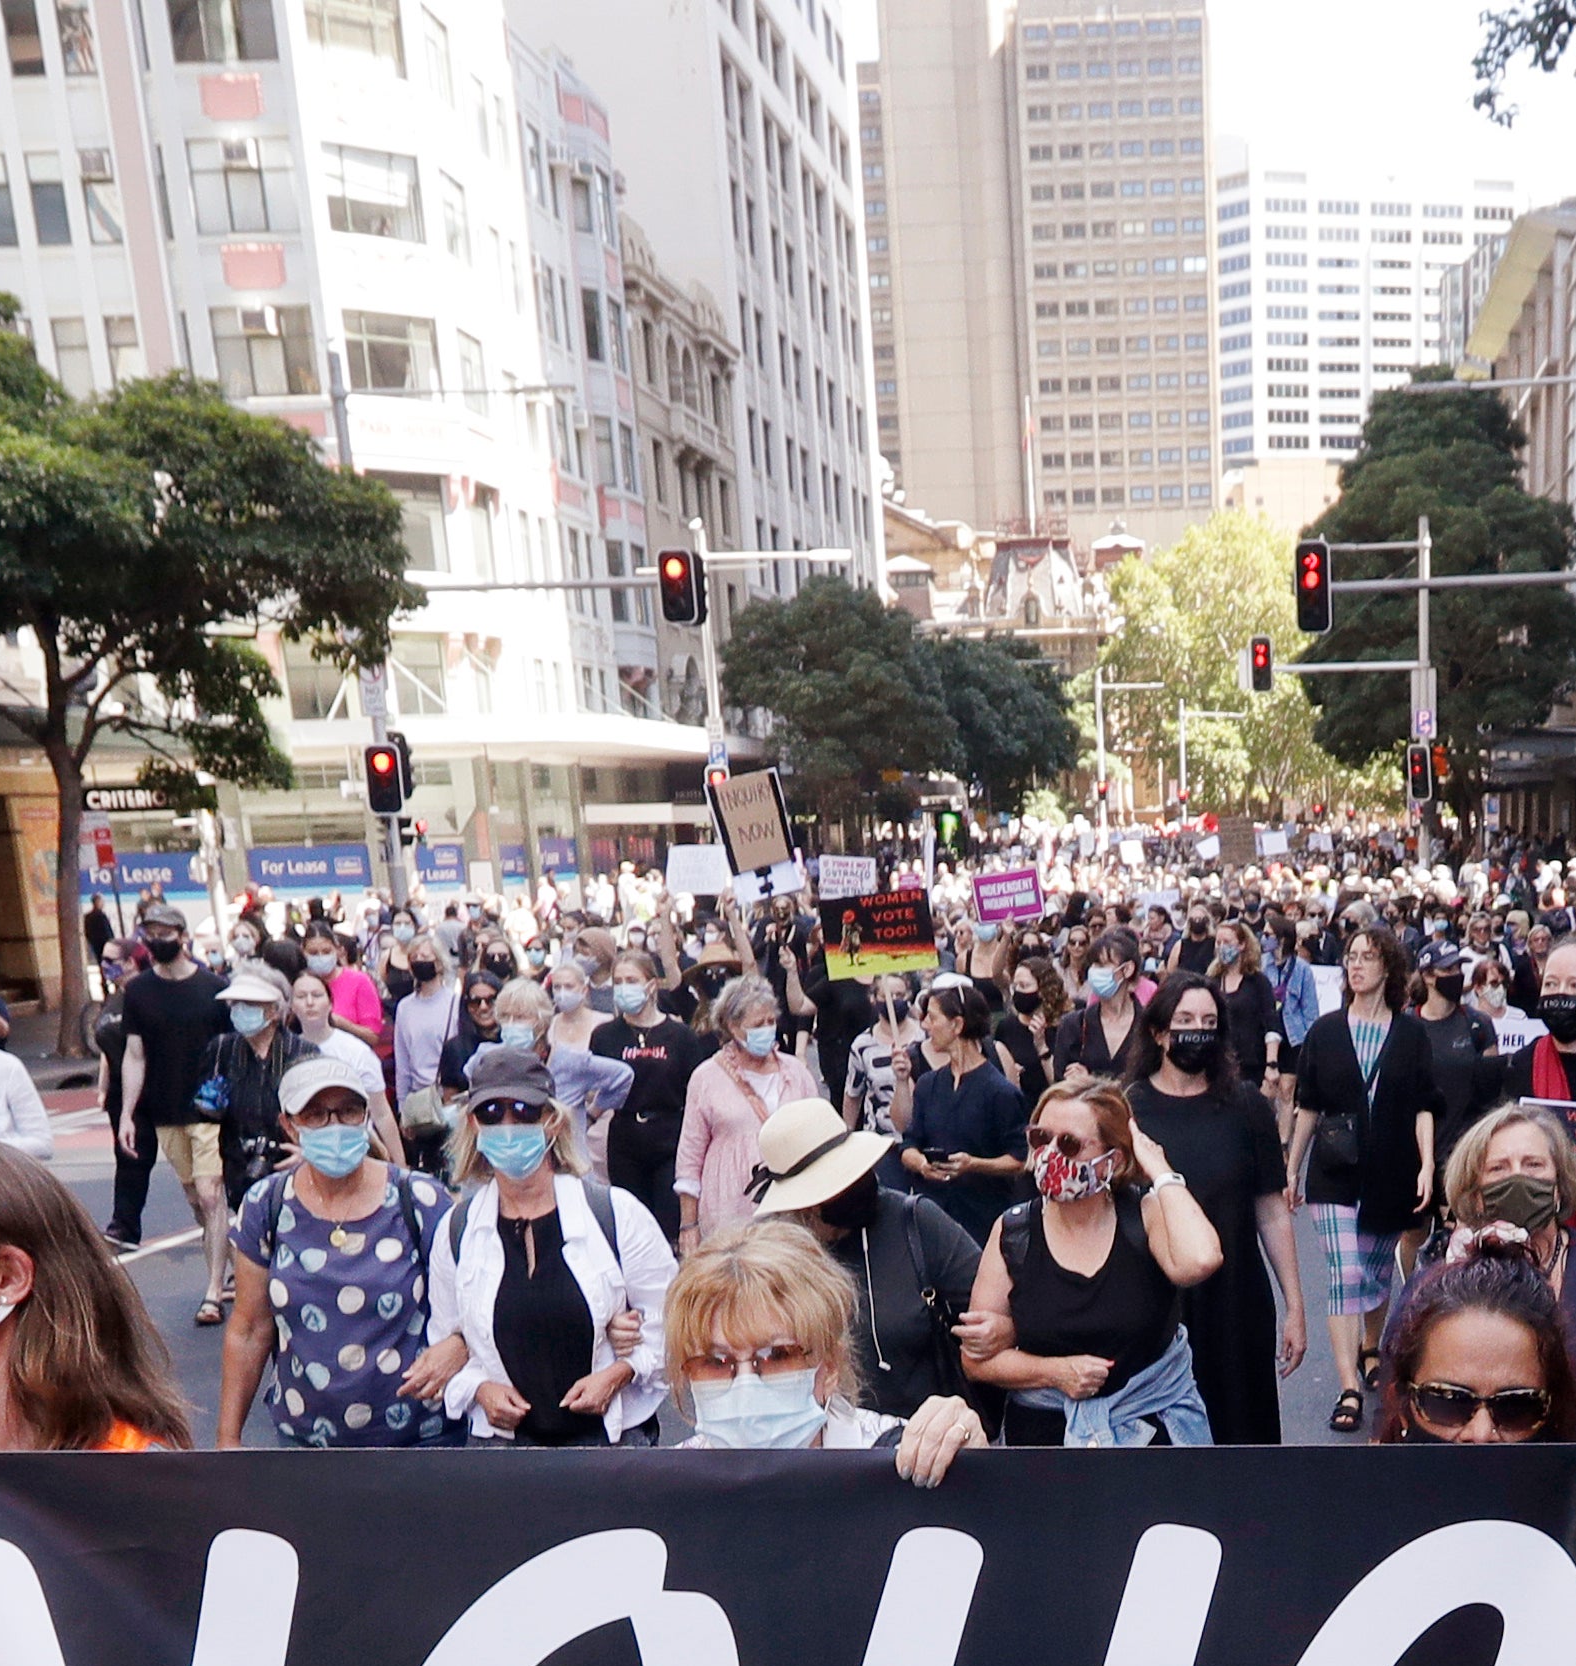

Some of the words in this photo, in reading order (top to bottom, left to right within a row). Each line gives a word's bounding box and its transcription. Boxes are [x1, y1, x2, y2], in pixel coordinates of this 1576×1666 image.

[1419, 711, 1430, 726] P
[86, 789, 168, 810] CRITERIO
[719, 782, 772, 812] INQUIRY
[738, 818, 775, 846] NOW
[122, 865, 173, 884] Lease
[261, 860, 285, 876] For
[288, 857, 328, 876] Lease
[427, 866, 457, 881] Lease
[979, 877, 1034, 897] INDEPENDENT
[860, 889, 923, 908] WOMEN
[872, 907, 915, 923] VOTE
[874, 924, 918, 940] TOO!!
